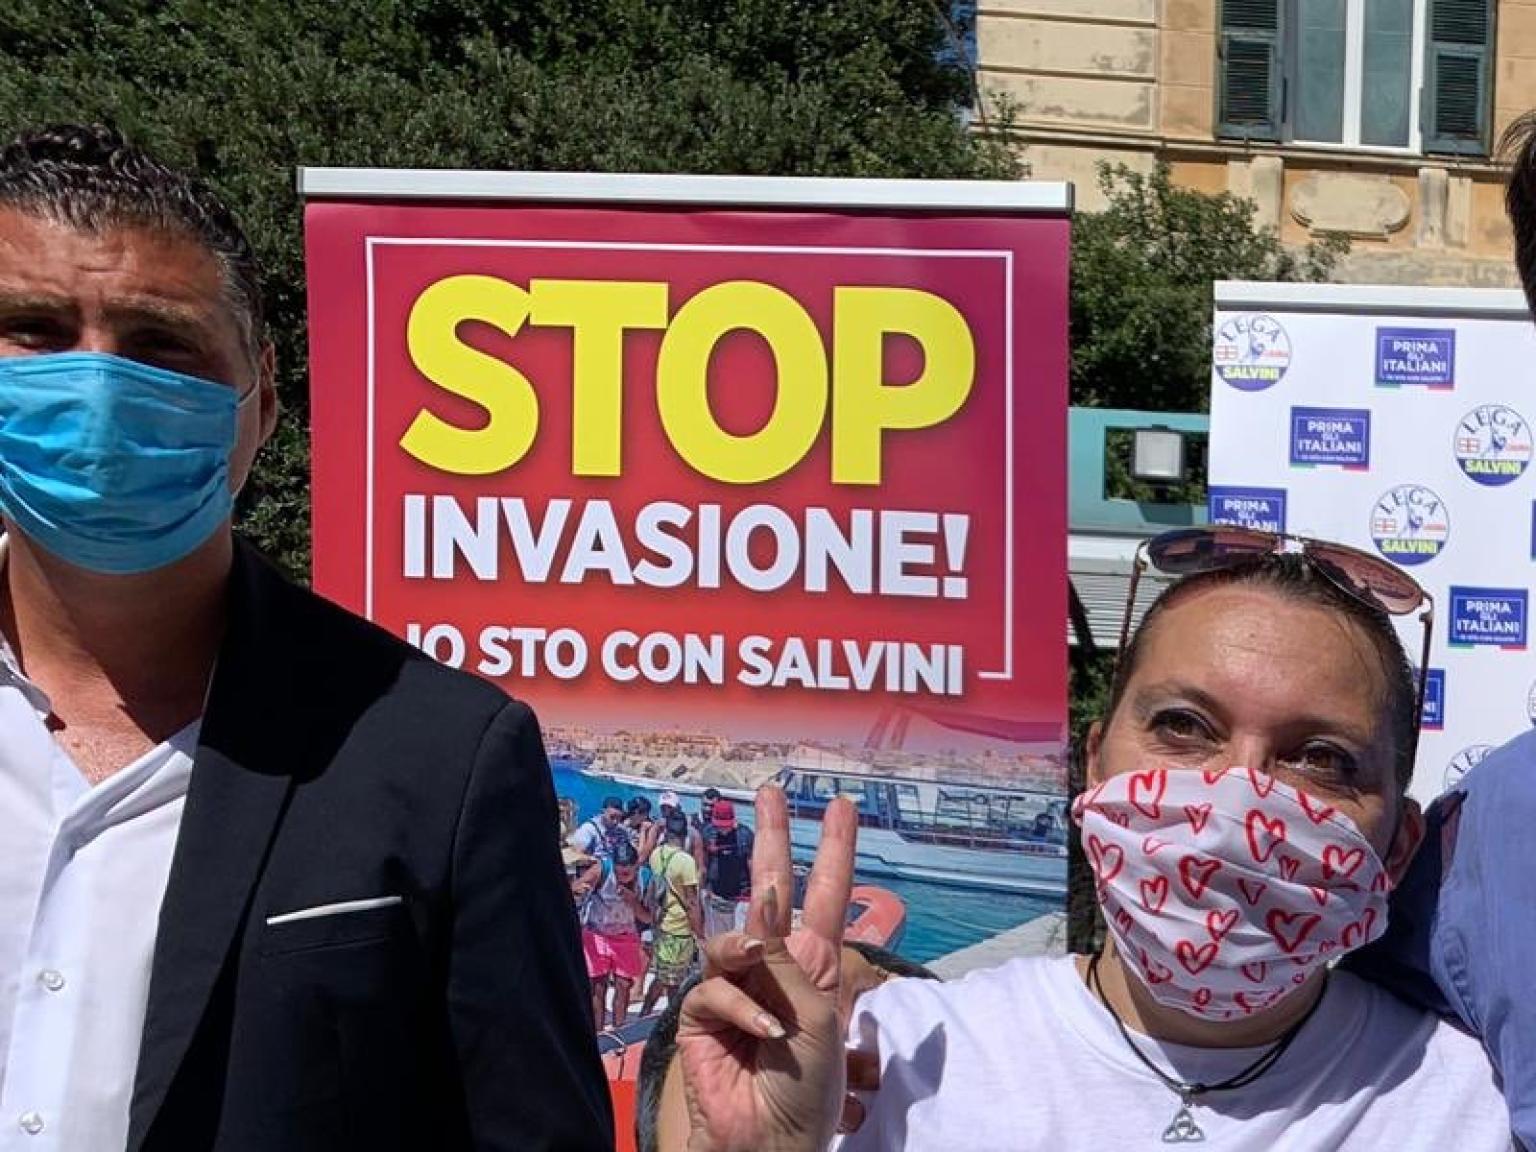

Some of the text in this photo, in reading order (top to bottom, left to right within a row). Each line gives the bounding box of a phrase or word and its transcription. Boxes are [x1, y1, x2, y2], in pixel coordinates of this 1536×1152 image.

[1393, 340, 1439, 354] PRIMA
[1383, 358, 1448, 373] ITALIANI
[399, 273, 976, 486] STOP
[1307, 420, 1354, 434] PRIMA
[1461, 407, 1521, 436] LEGA
[1298, 439, 1362, 453] ITALIANI
[1223, 499, 1270, 513] PRIMA
[1379, 488, 1438, 516] LEGA
[403, 494, 970, 599] INVASIONE!
[1466, 600, 1512, 614] PRIMA
[1456, 619, 1520, 633] ITALIANI
[477, 627, 588, 681] STO
[600, 631, 724, 686] CON
[737, 635, 964, 697] SALVINI
